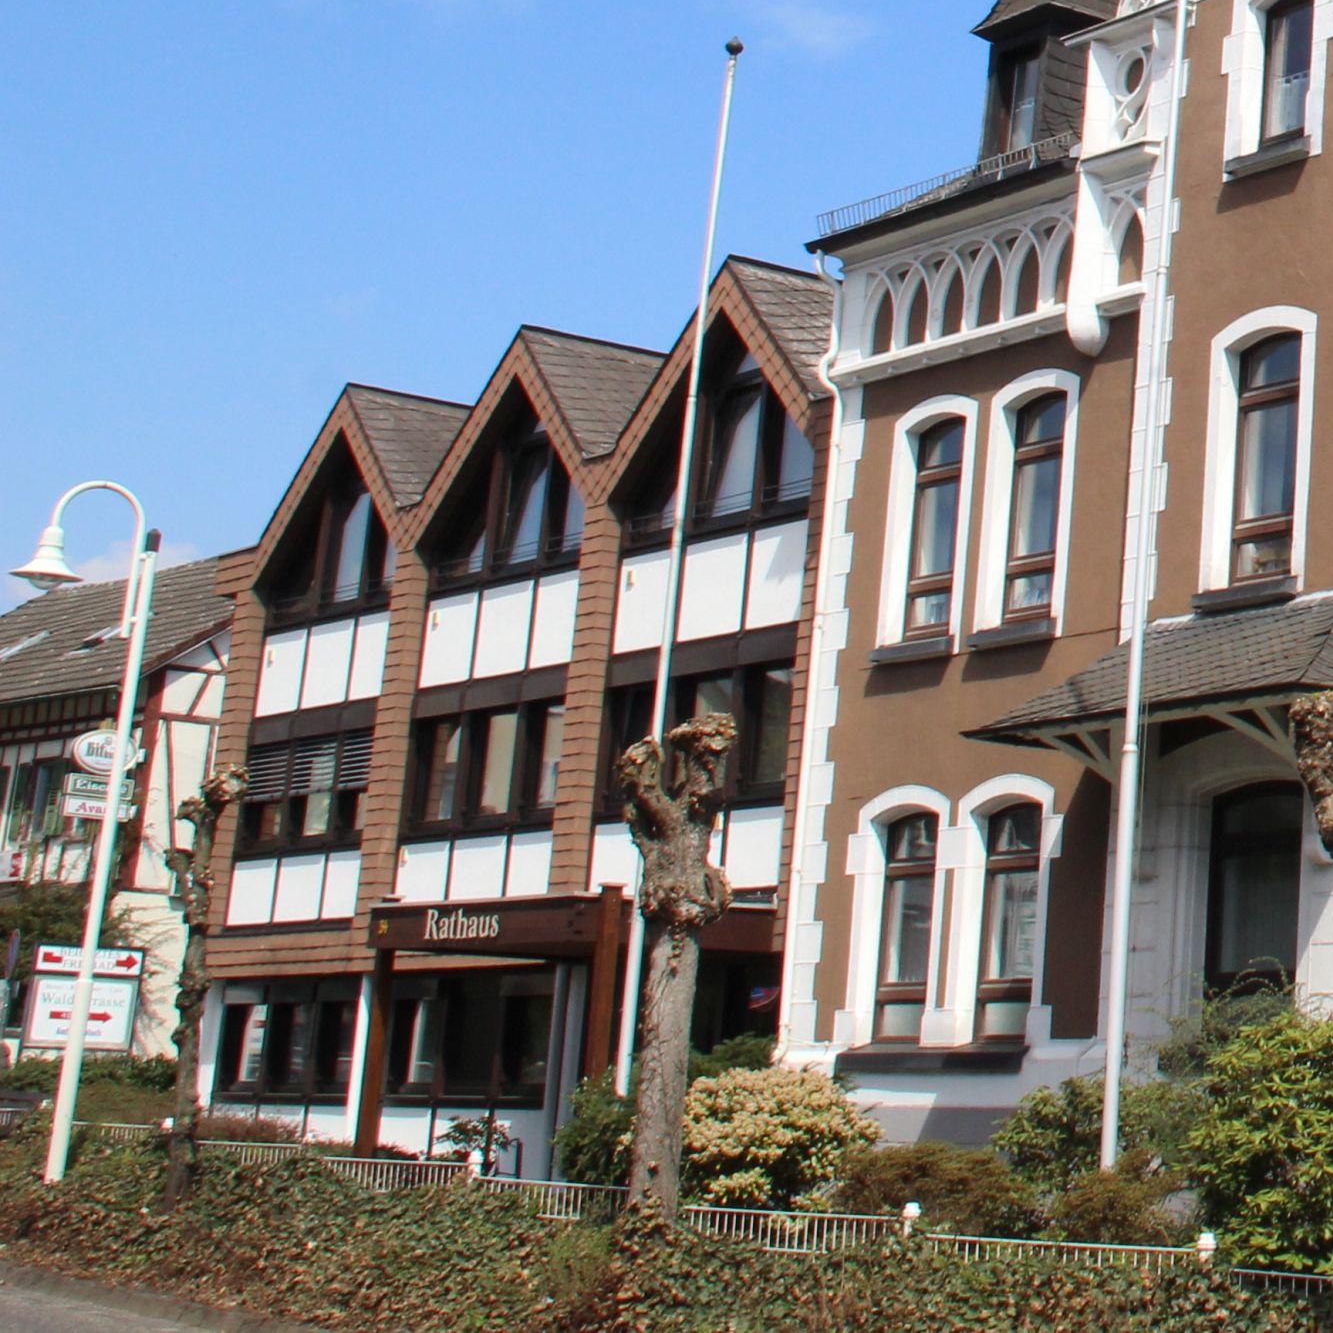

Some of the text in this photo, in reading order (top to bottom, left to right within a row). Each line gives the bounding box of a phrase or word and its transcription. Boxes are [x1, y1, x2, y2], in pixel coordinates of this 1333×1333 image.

[424, 908, 499, 940] Rathaus
[60, 947, 120, 960] BEHZTES
[42, 991, 126, 1008] Waldrasse
